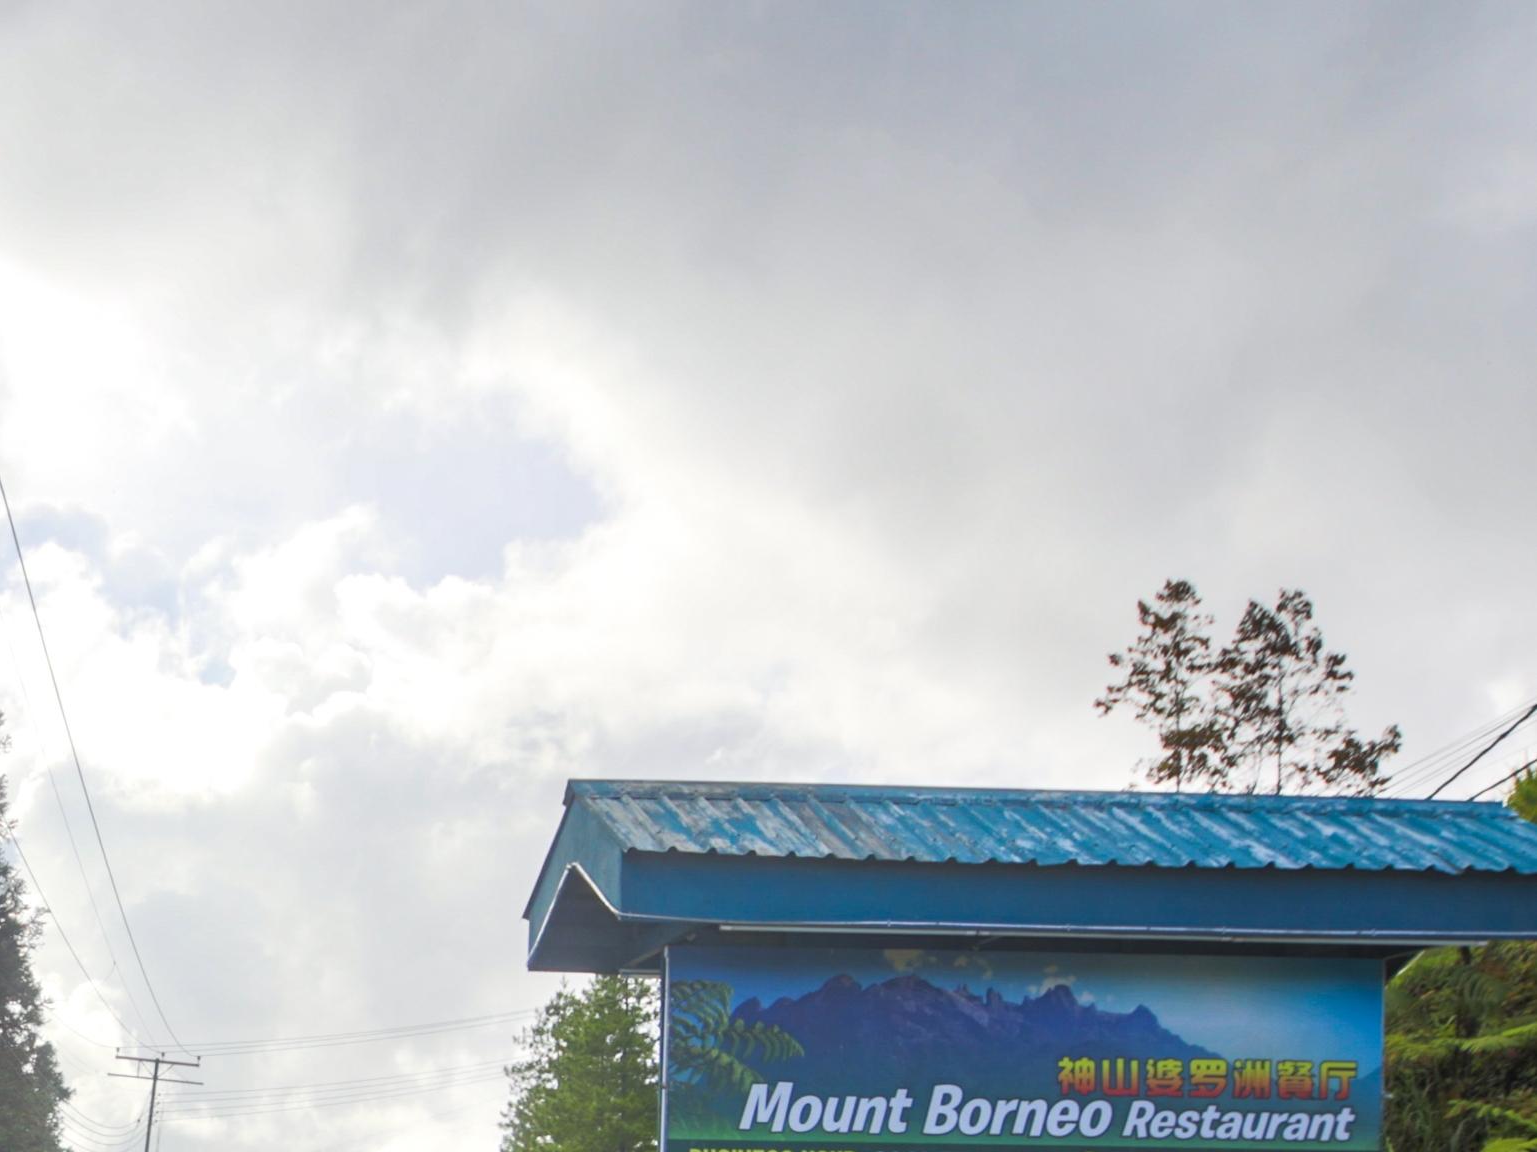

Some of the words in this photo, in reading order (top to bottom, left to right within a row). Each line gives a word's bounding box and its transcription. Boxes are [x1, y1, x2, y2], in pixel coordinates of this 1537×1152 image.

[739, 1081, 914, 1135] Mount
[923, 1084, 1113, 1138] Borneo
[1122, 1100, 1355, 1142] Restaurant
